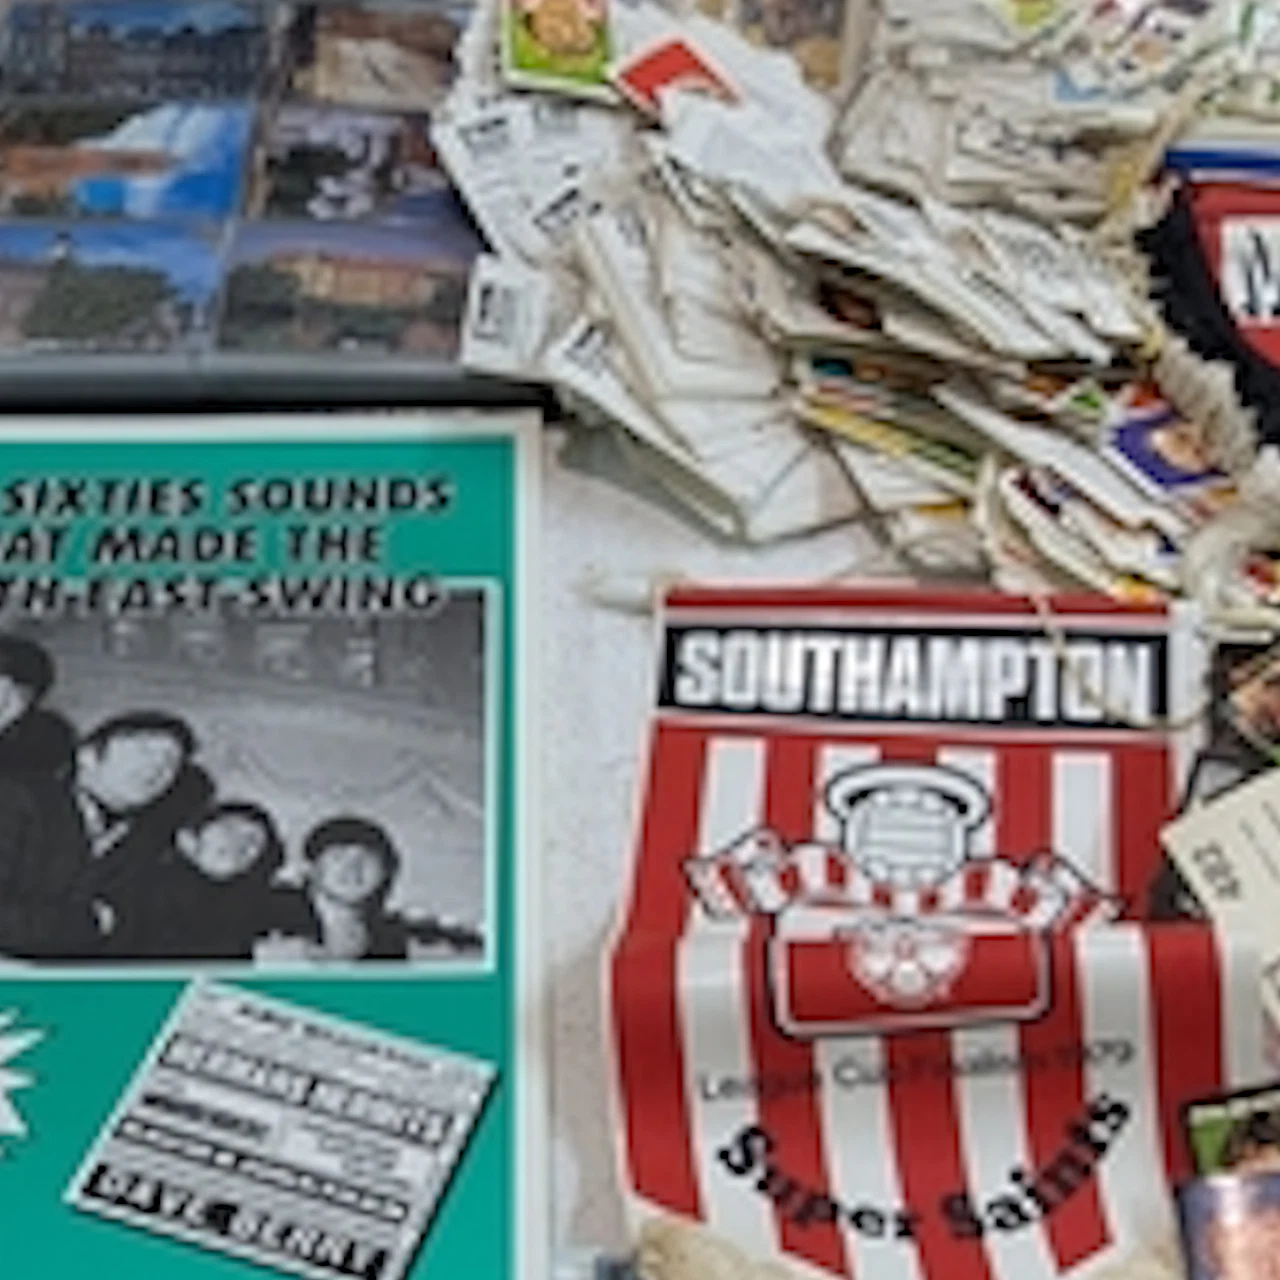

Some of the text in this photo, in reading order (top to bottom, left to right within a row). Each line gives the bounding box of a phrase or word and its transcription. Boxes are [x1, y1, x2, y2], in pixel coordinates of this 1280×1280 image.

[1, 476, 204, 516] SIXTIES
[225, 474, 453, 514] SOUNDS
[91, 524, 258, 564] MADE
[286, 523, 385, 563] THE
[674, 629, 1152, 720] SOUTHAMPTON
[94, 1165, 210, 1225] DAVE
[718, 1090, 1131, 1240] Super Saints
